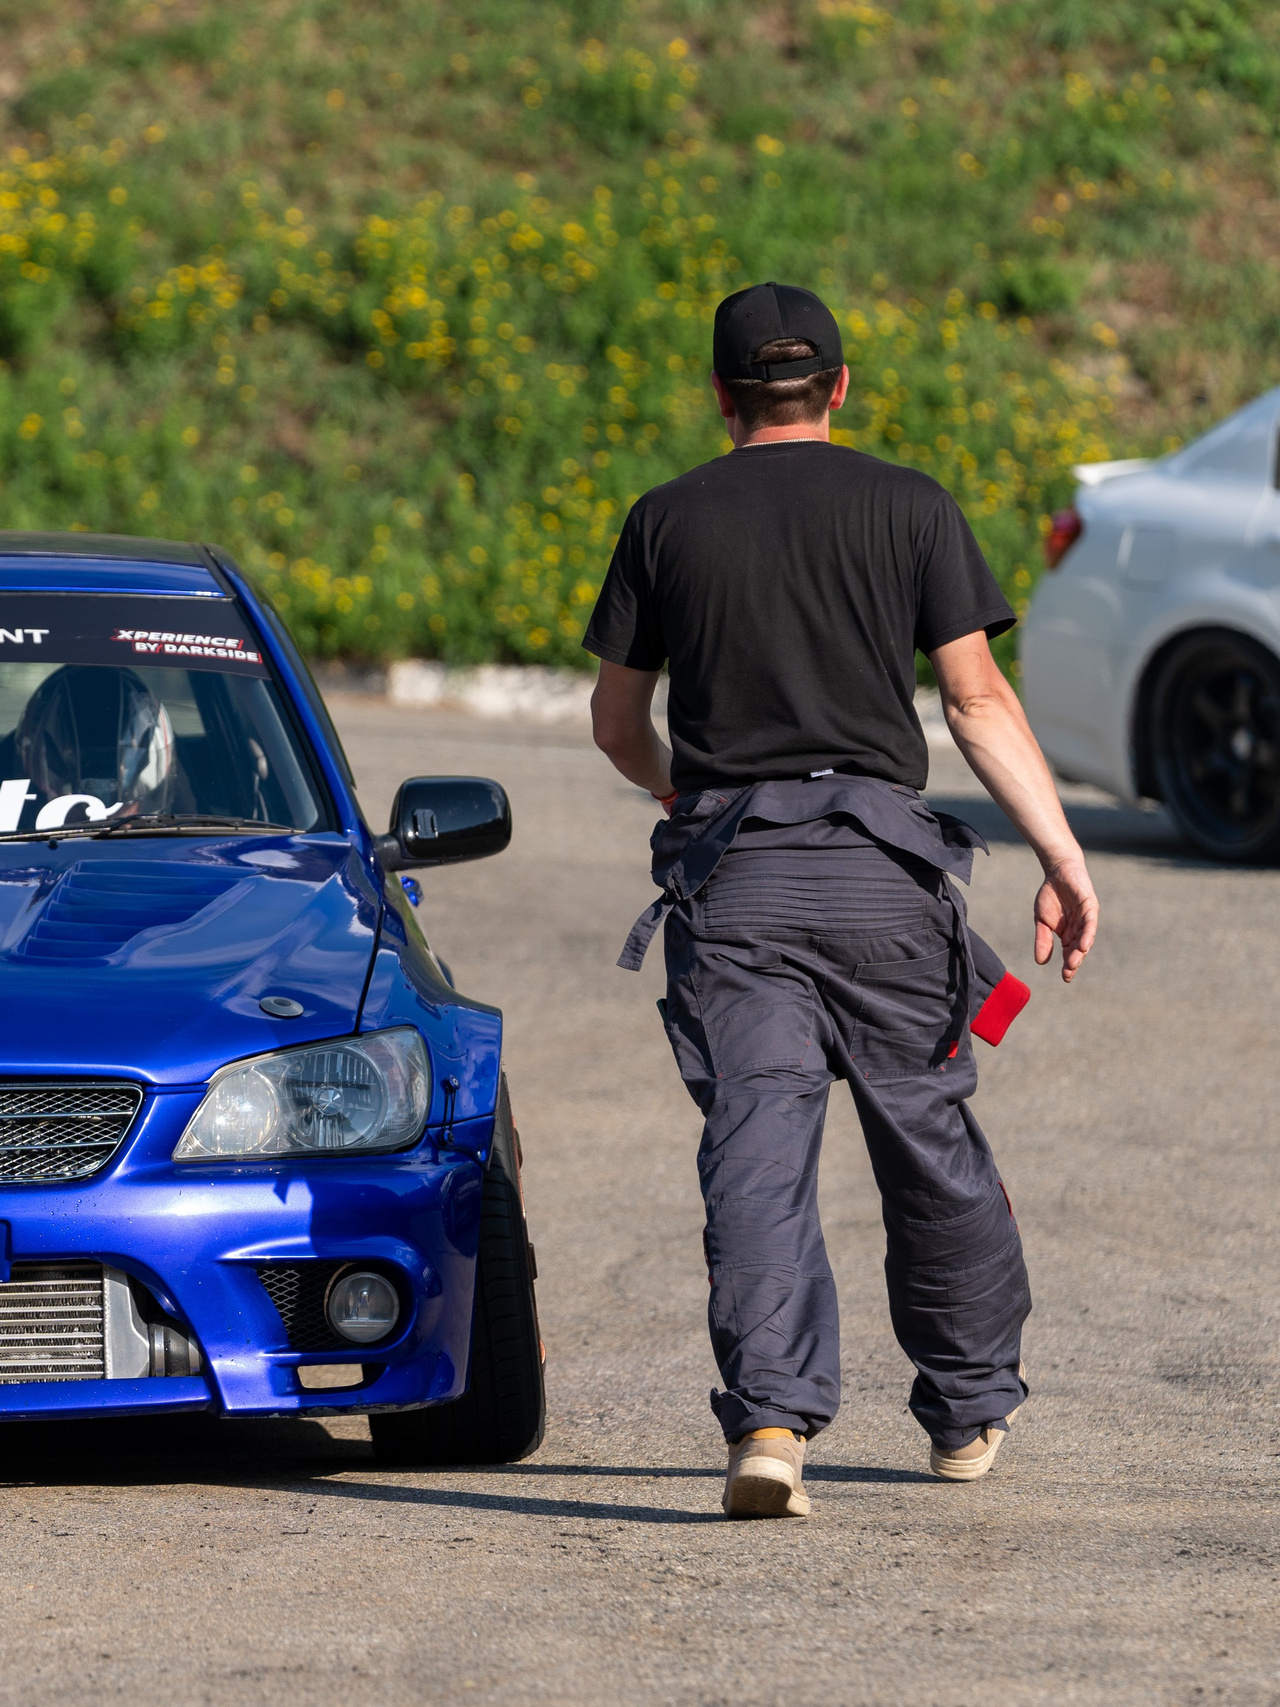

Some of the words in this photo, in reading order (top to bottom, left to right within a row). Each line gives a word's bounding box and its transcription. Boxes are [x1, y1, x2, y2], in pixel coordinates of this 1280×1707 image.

[116, 629, 240, 648] XPERIENCE
[134, 641, 159, 653] BY
[163, 643, 259, 662] DARKSIDE
